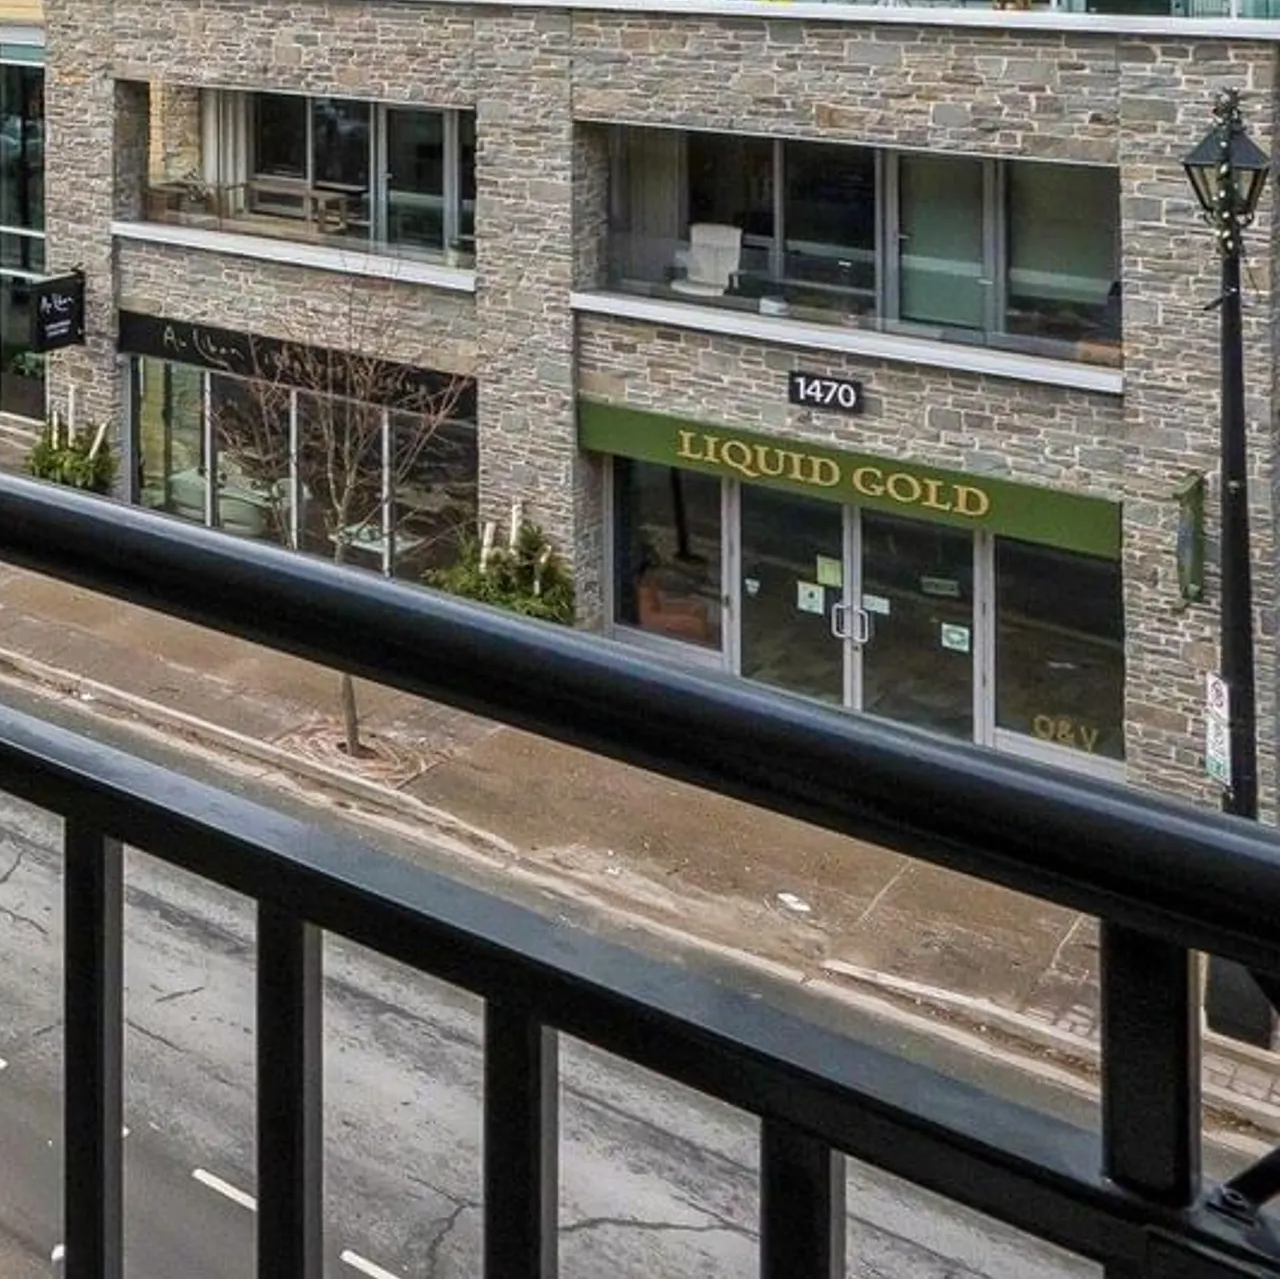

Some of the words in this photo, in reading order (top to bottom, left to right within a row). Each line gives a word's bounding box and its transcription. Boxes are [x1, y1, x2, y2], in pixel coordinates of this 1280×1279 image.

[794, 376, 857, 408] 1470
[677, 429, 841, 487] LIQUID
[852, 467, 990, 517] GOLD
